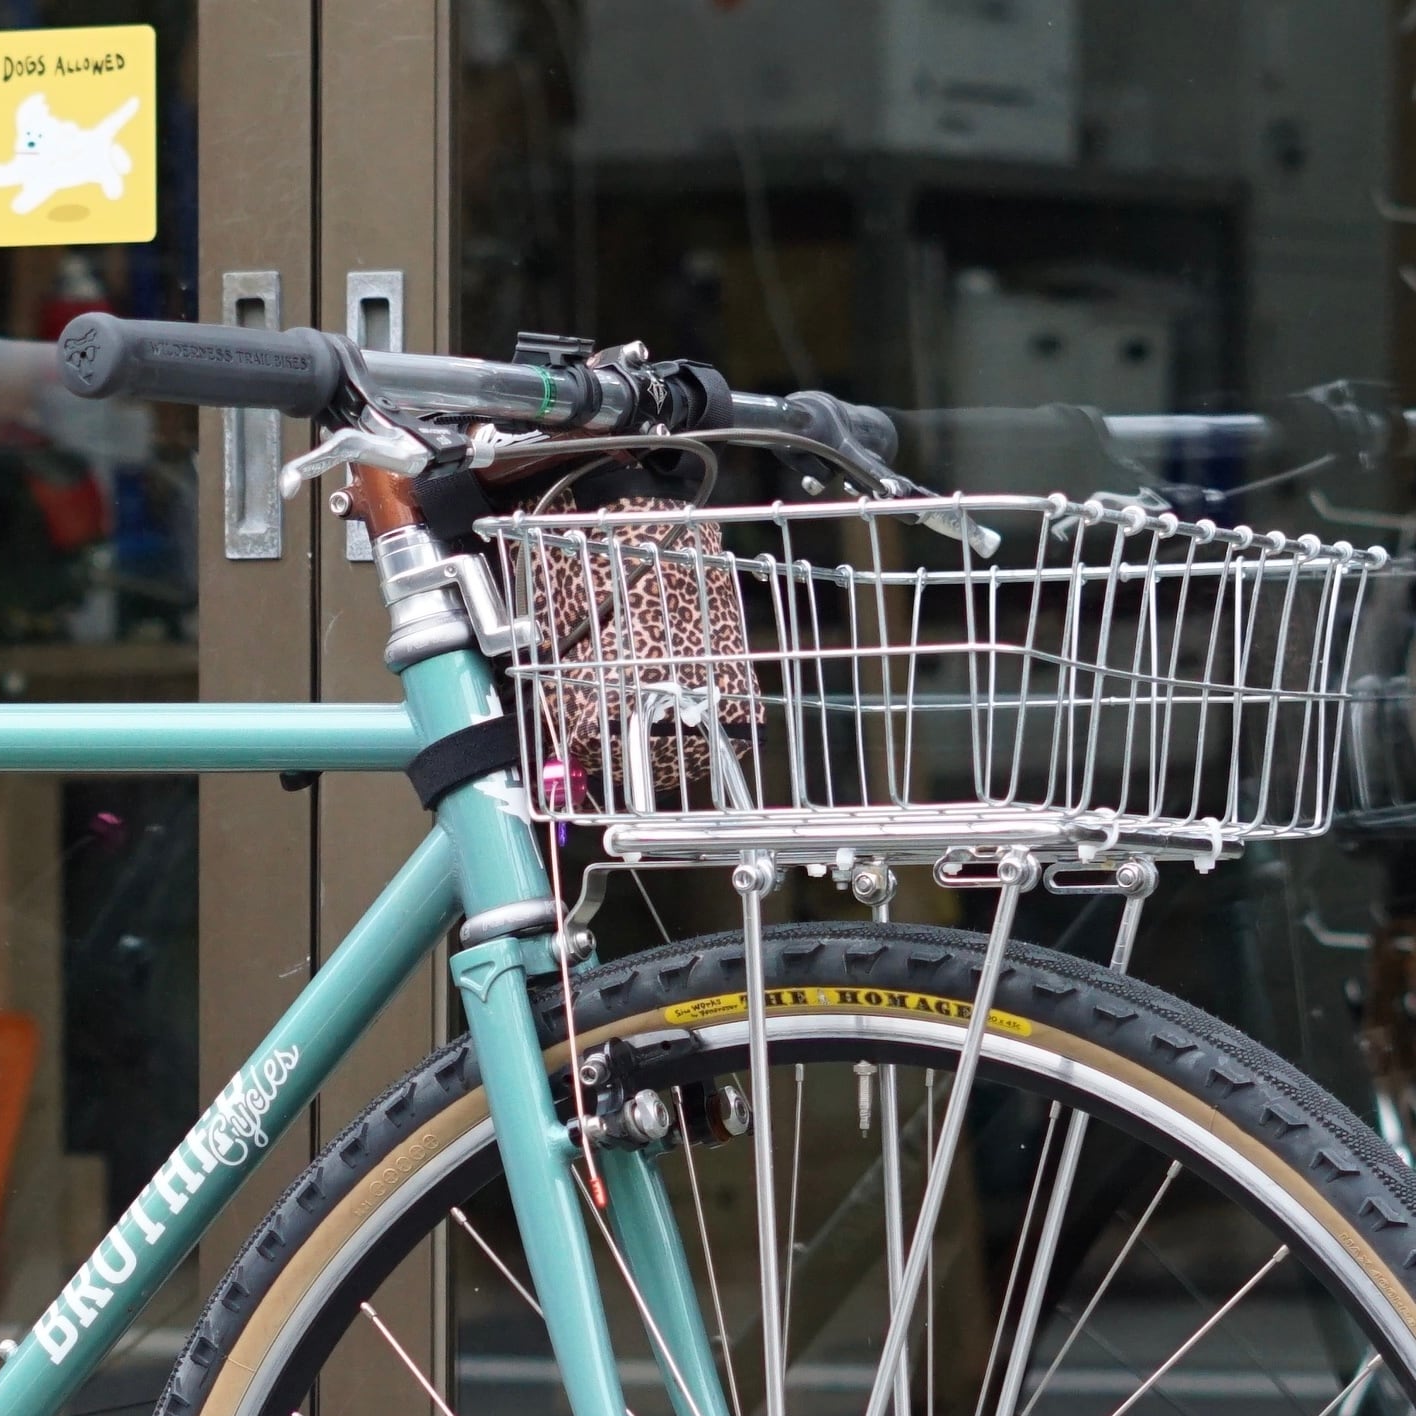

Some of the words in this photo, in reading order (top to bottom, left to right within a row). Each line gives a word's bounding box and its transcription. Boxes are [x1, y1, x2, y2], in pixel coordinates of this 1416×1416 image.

[3, 55, 46, 82] DOGS
[55, 53, 125, 76] ALLOWED
[837, 989, 973, 1019] HOMAGE
[208, 1044, 300, 1167] Cycles
